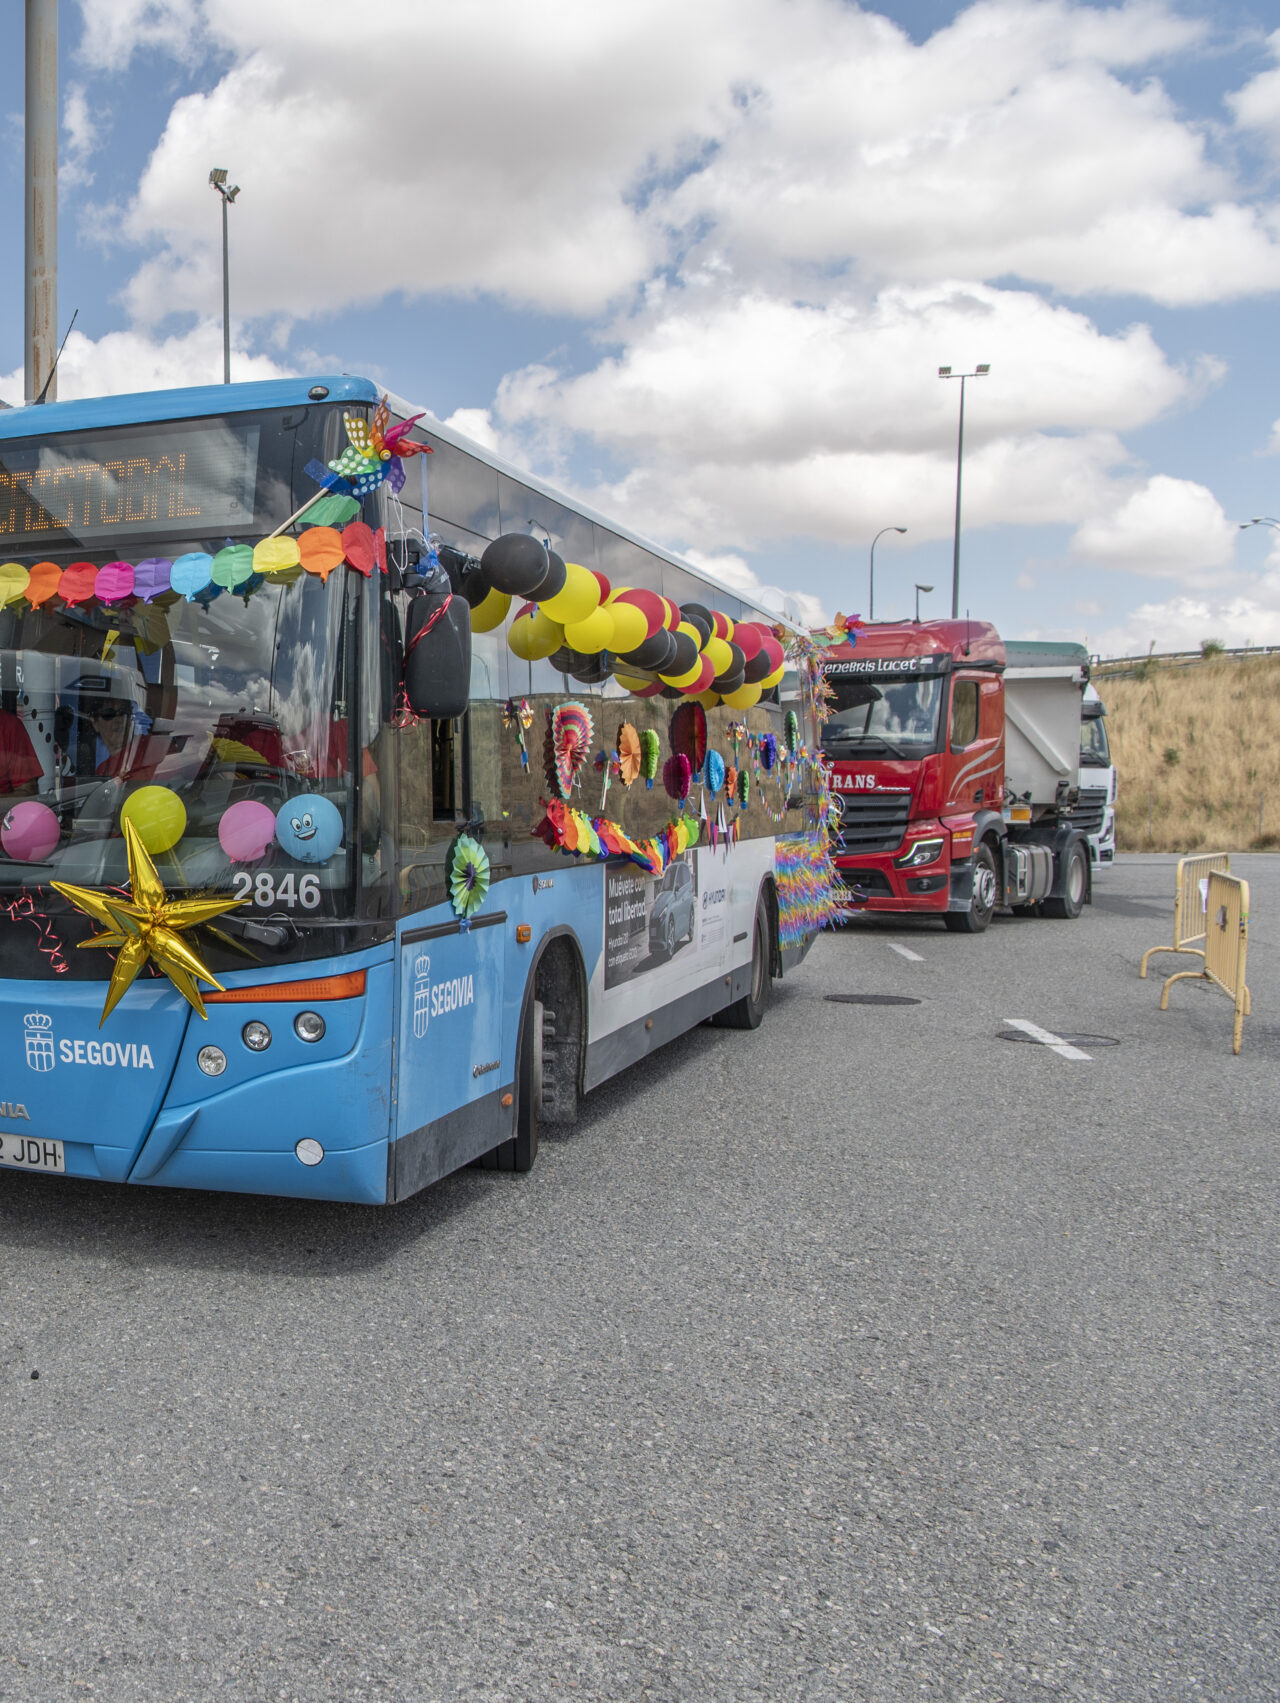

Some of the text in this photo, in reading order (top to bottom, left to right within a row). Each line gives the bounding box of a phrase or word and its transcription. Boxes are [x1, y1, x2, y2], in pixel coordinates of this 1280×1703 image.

[232, 872, 321, 909] 2846
[431, 974, 475, 1018] SEGOVIA
[59, 1038, 155, 1070] SEGOVIA
[13, 1138, 58, 1168] JDH
